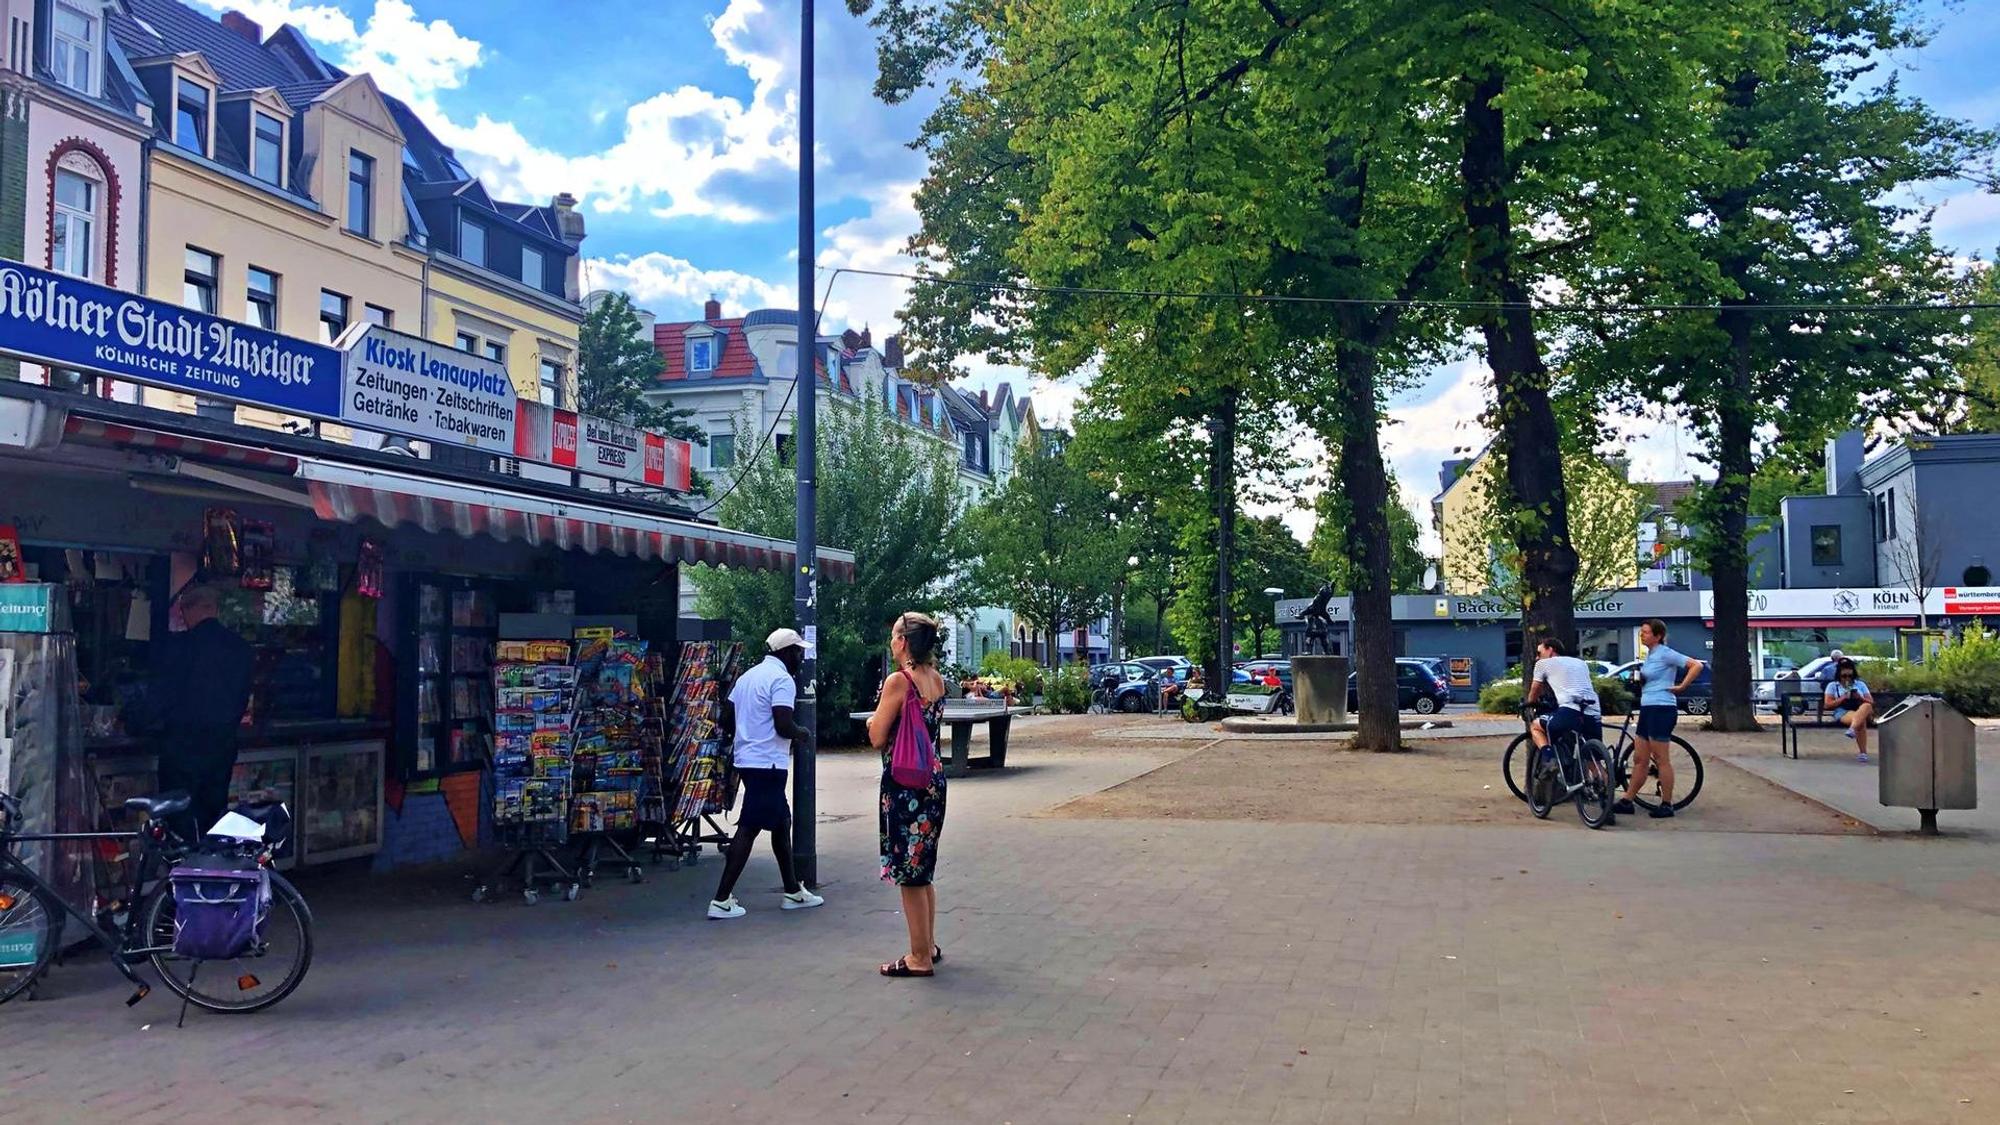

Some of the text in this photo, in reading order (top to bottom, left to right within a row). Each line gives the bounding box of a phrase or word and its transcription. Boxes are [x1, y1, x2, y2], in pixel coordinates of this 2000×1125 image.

[0, 268, 315, 386] Kölner Stadt-Anzeiger
[95, 345, 241, 389] KÖLNISCHE ZEITUNG
[365, 336, 507, 397] Kiosk Lenauplatz
[353, 391, 506, 442] Getränke Tabakwaren
[355, 367, 514, 422] Zeitungen Zeitschriften
[597, 446, 626, 464] EXPRESS
[0, 601, 46, 617] eitung
[1873, 590, 1909, 604] KÖLN
